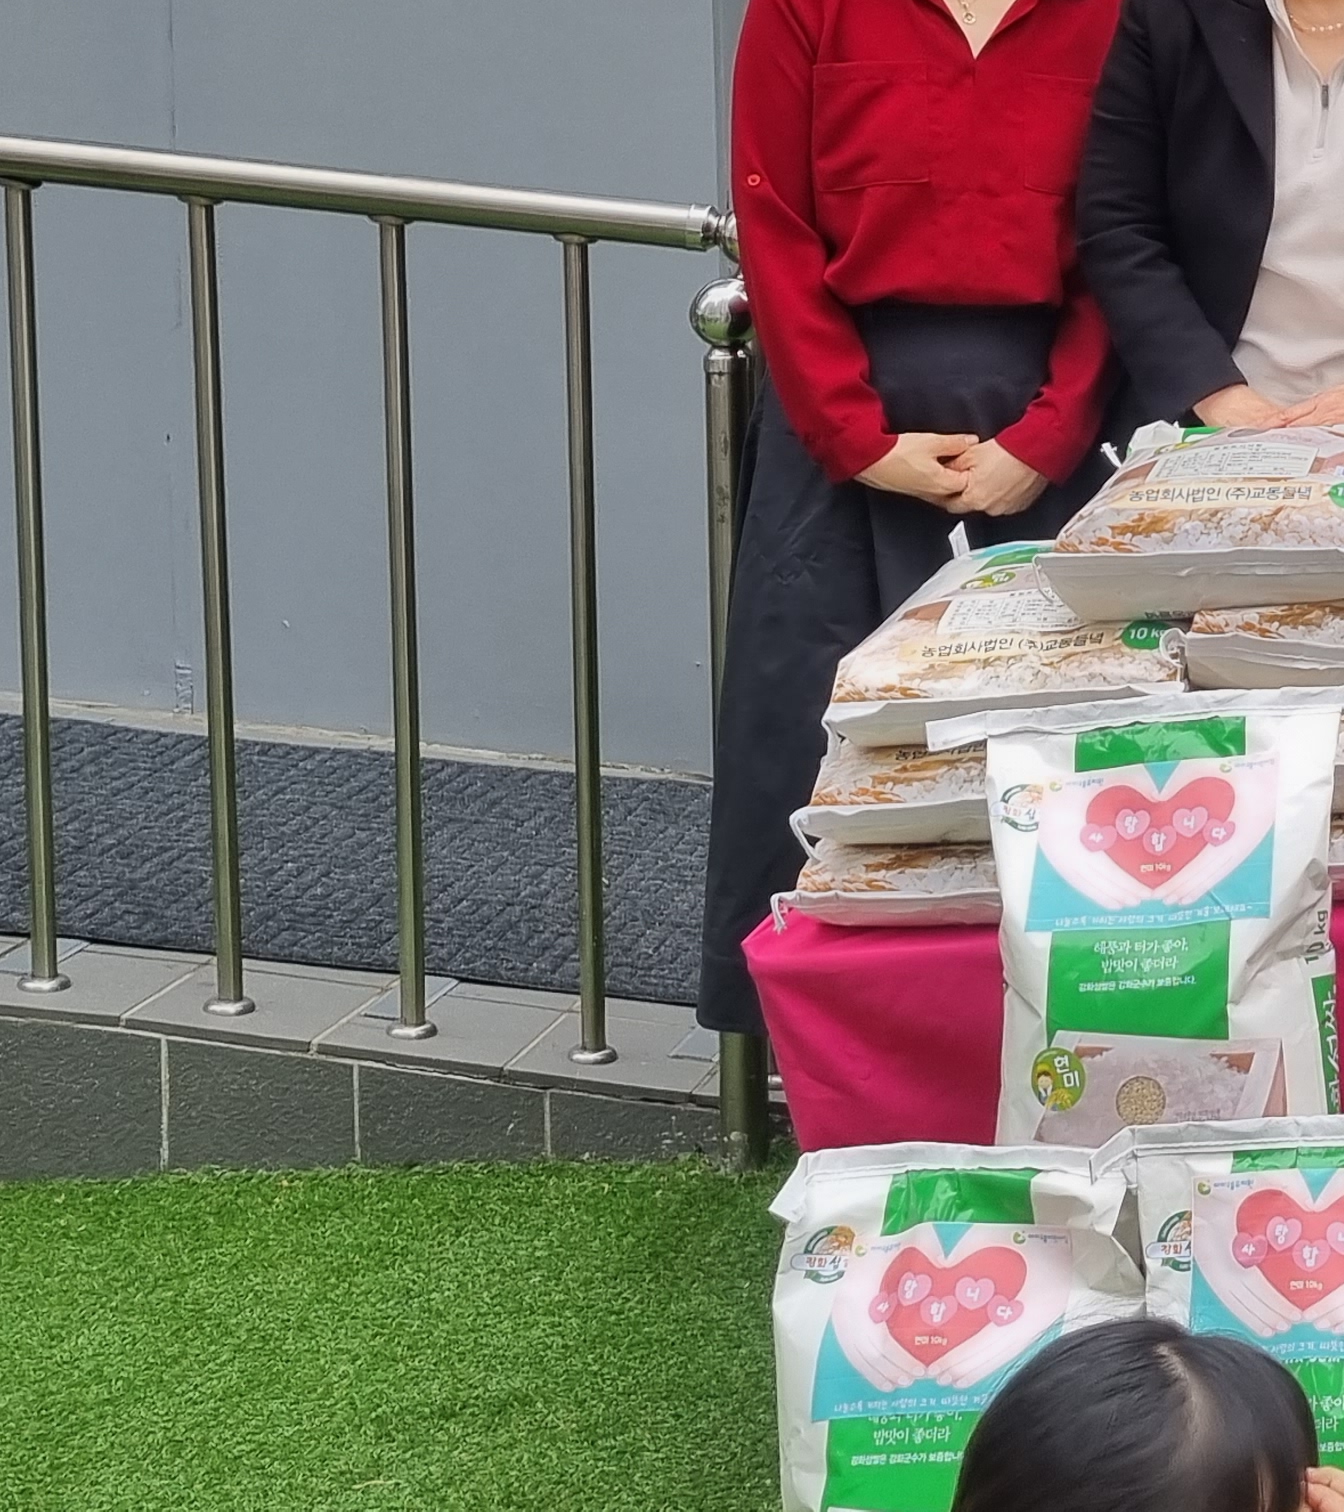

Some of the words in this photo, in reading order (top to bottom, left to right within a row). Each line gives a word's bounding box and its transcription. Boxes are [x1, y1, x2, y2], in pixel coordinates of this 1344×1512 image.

[1129, 487, 1222, 503] 농업회사법인
[1129, 627, 1148, 640] 10
[921, 637, 1014, 657] 농업회사법인
[1314, 910, 1329, 935] kg
[1054, 1055, 1080, 1088] 현미
[874, 1428, 909, 1446] 밥맛이
[912, 1426, 951, 1444] 좋더라
